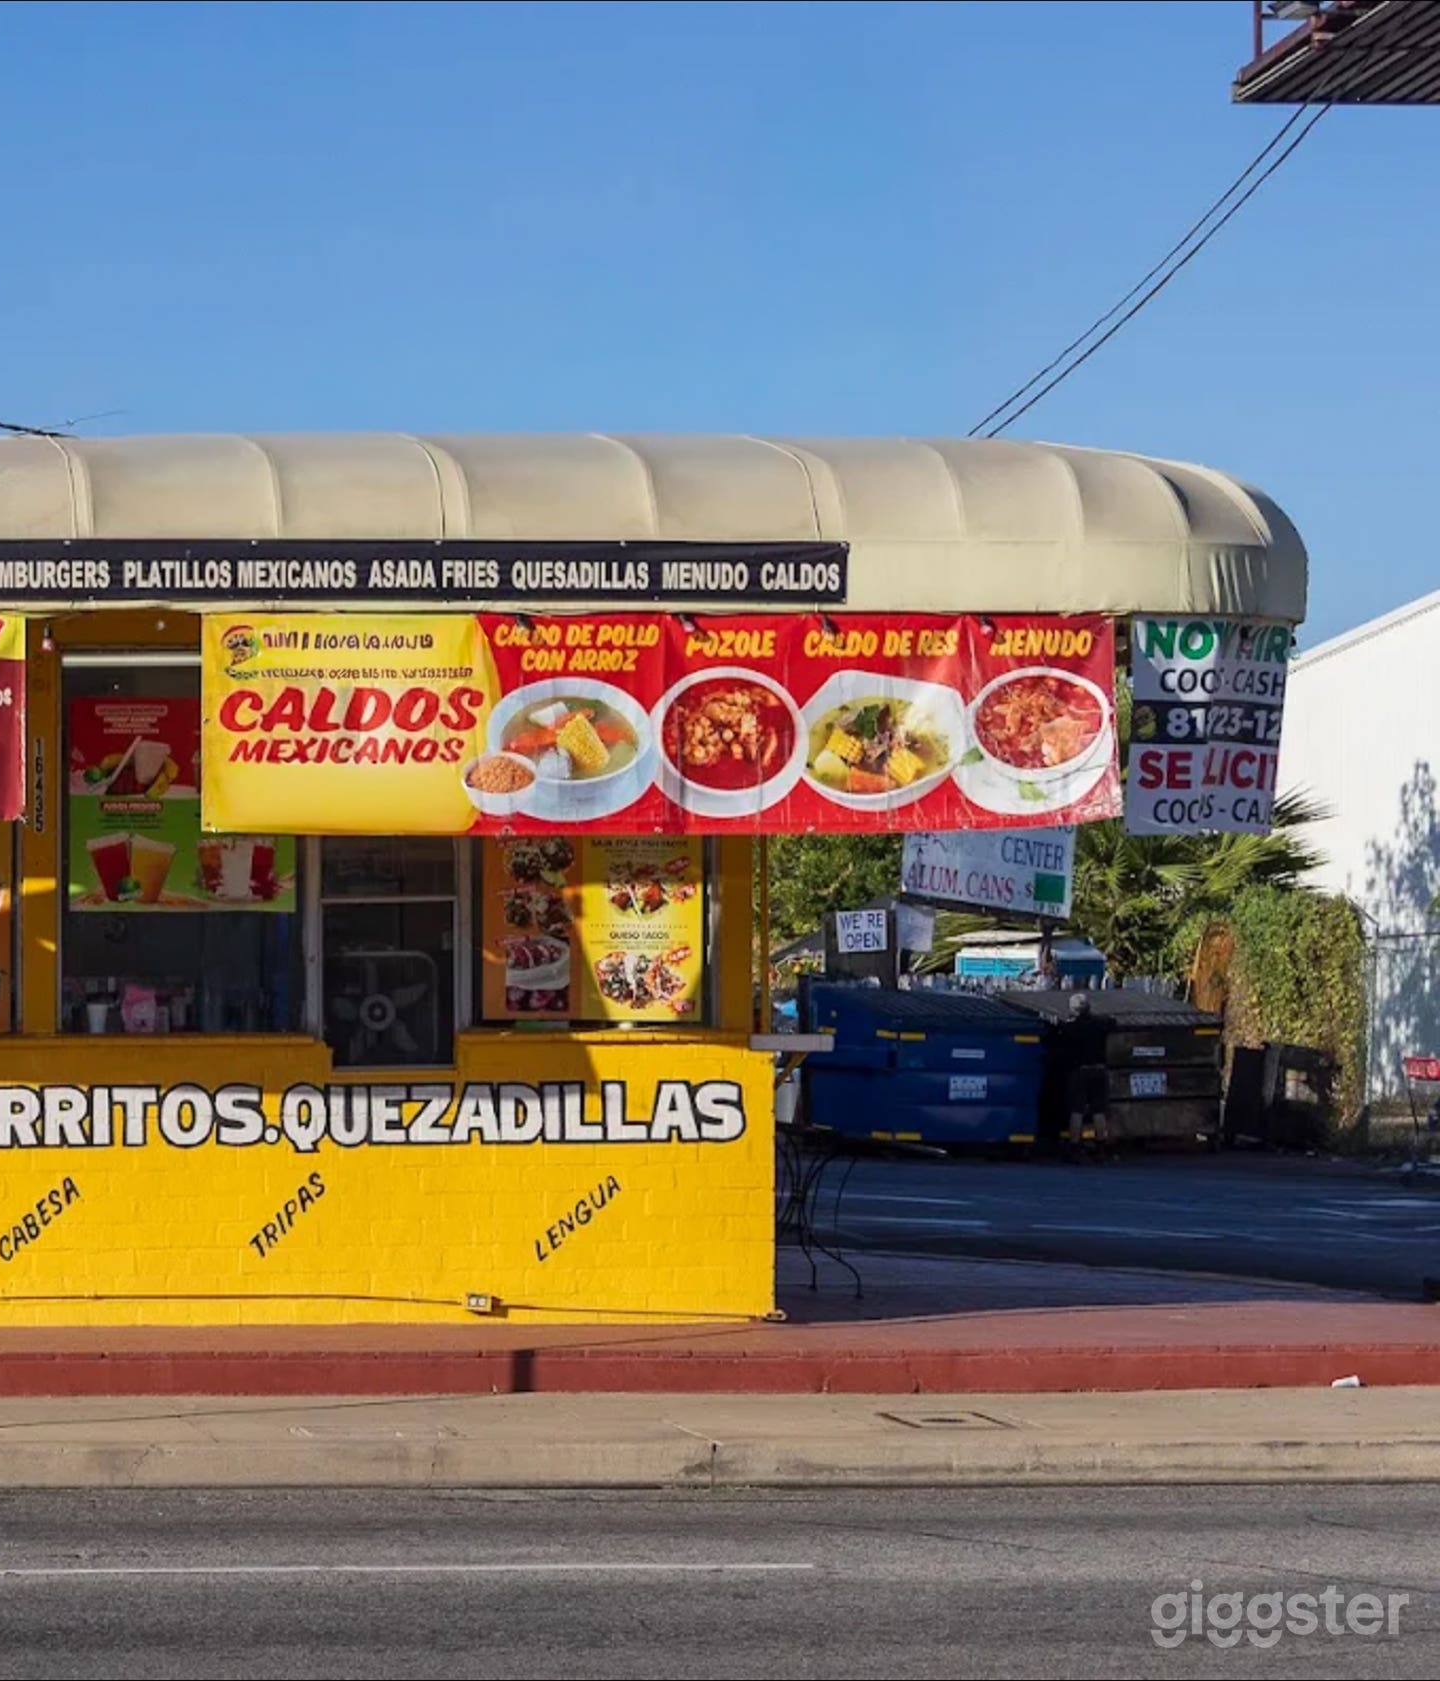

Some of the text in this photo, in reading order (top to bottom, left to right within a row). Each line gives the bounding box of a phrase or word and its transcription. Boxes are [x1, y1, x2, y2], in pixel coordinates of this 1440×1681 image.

[122, 560, 232, 589] PLATILLOS
[237, 560, 357, 589] MEXICANOS
[367, 560, 437, 589] ASADA
[441, 560, 500, 589] FRIES
[511, 560, 650, 591] QUESADILLAS
[661, 561, 749, 591] MENUDO
[760, 562, 841, 592] CALDOS
[494, 624, 661, 648] CALDO DE POLLO
[685, 629, 778, 659] POZOLE
[803, 629, 960, 658] CALDO DE RES
[990, 628, 1093, 659] MENUDO
[521, 649, 640, 672] CON ARROZ
[218, 685, 485, 734] CALDOS
[228, 736, 465, 765] MEXICANOS
[1138, 750, 1193, 791] SE
[1000, 836, 1064, 871] CENTER
[844, 932, 881, 950] OPEN
[249, 1171, 327, 1259] TRIPAS
[533, 1173, 623, 1263] LENGUA
